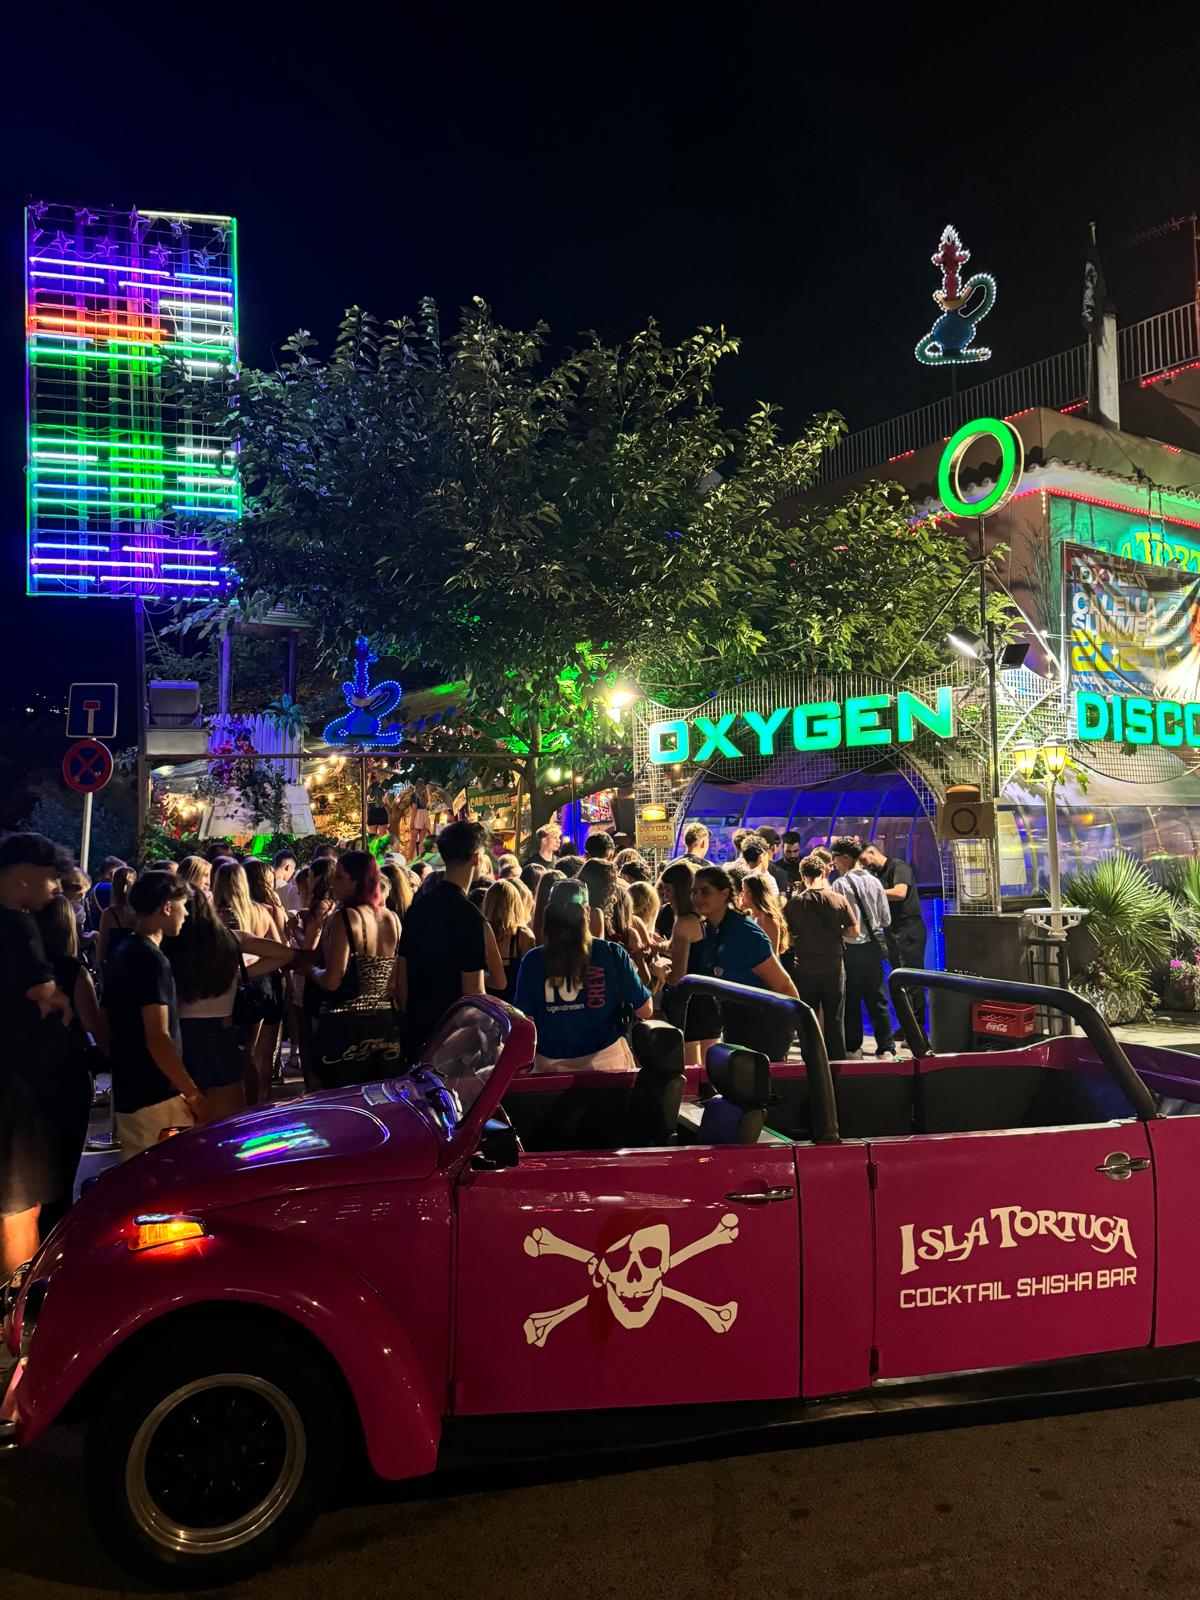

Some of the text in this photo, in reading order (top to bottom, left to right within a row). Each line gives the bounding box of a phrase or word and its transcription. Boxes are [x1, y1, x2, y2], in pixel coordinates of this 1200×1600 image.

[649, 686, 956, 765] OXYGEN
[639, 824, 672, 833] OXYGEN
[644, 834, 668, 843] DISCO
[588, 966, 606, 1009] CREW
[899, 1205, 1137, 1275] ISLA TORTUGA
[899, 1266, 1137, 1309] COCKTAIL SHISHA BAR
